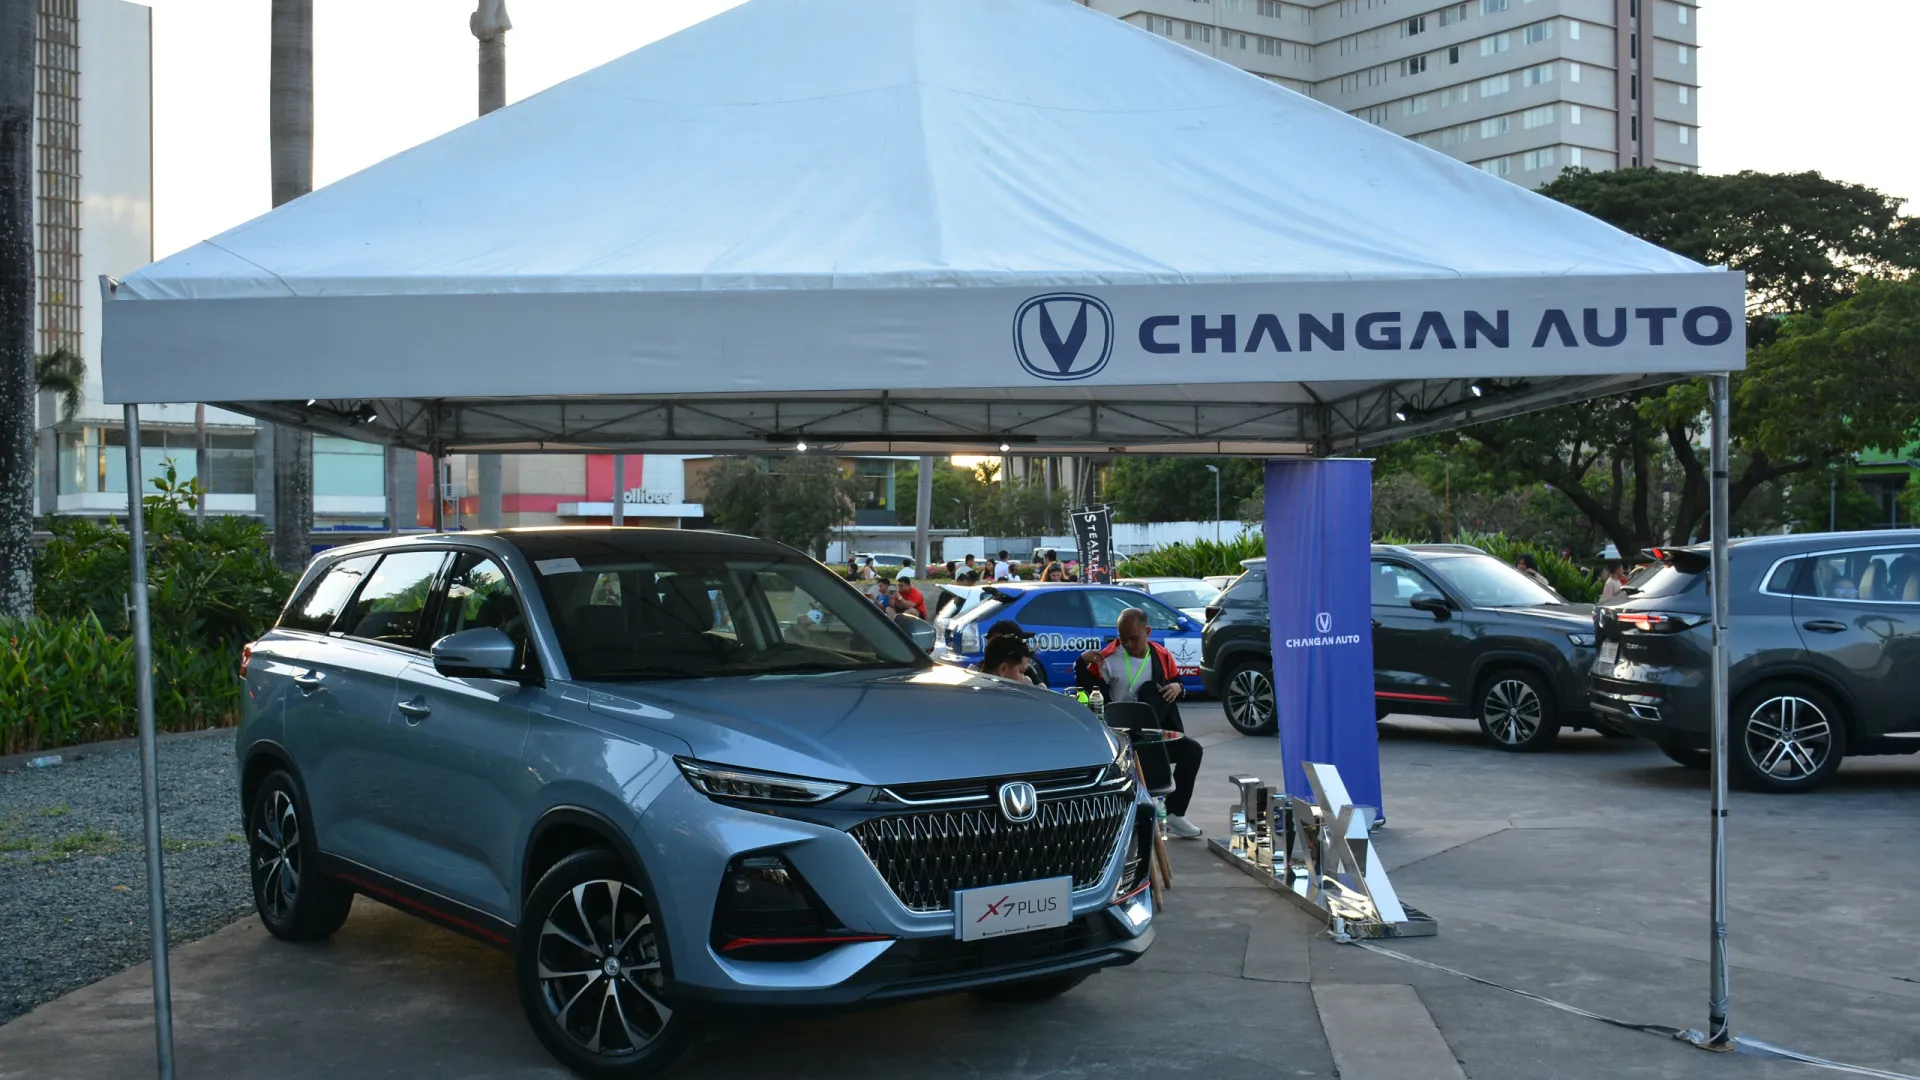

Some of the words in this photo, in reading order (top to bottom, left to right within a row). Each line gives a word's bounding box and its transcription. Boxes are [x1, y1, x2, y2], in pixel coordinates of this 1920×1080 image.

[1138, 310, 1510, 354] CHANGAN
[1531, 305, 1733, 350] AUTO
[612, 487, 671, 504] ollibee
[1084, 513, 1100, 572] STEALTH
[1286, 637, 1334, 648] CHANGAN
[1335, 634, 1360, 645] AUTO
